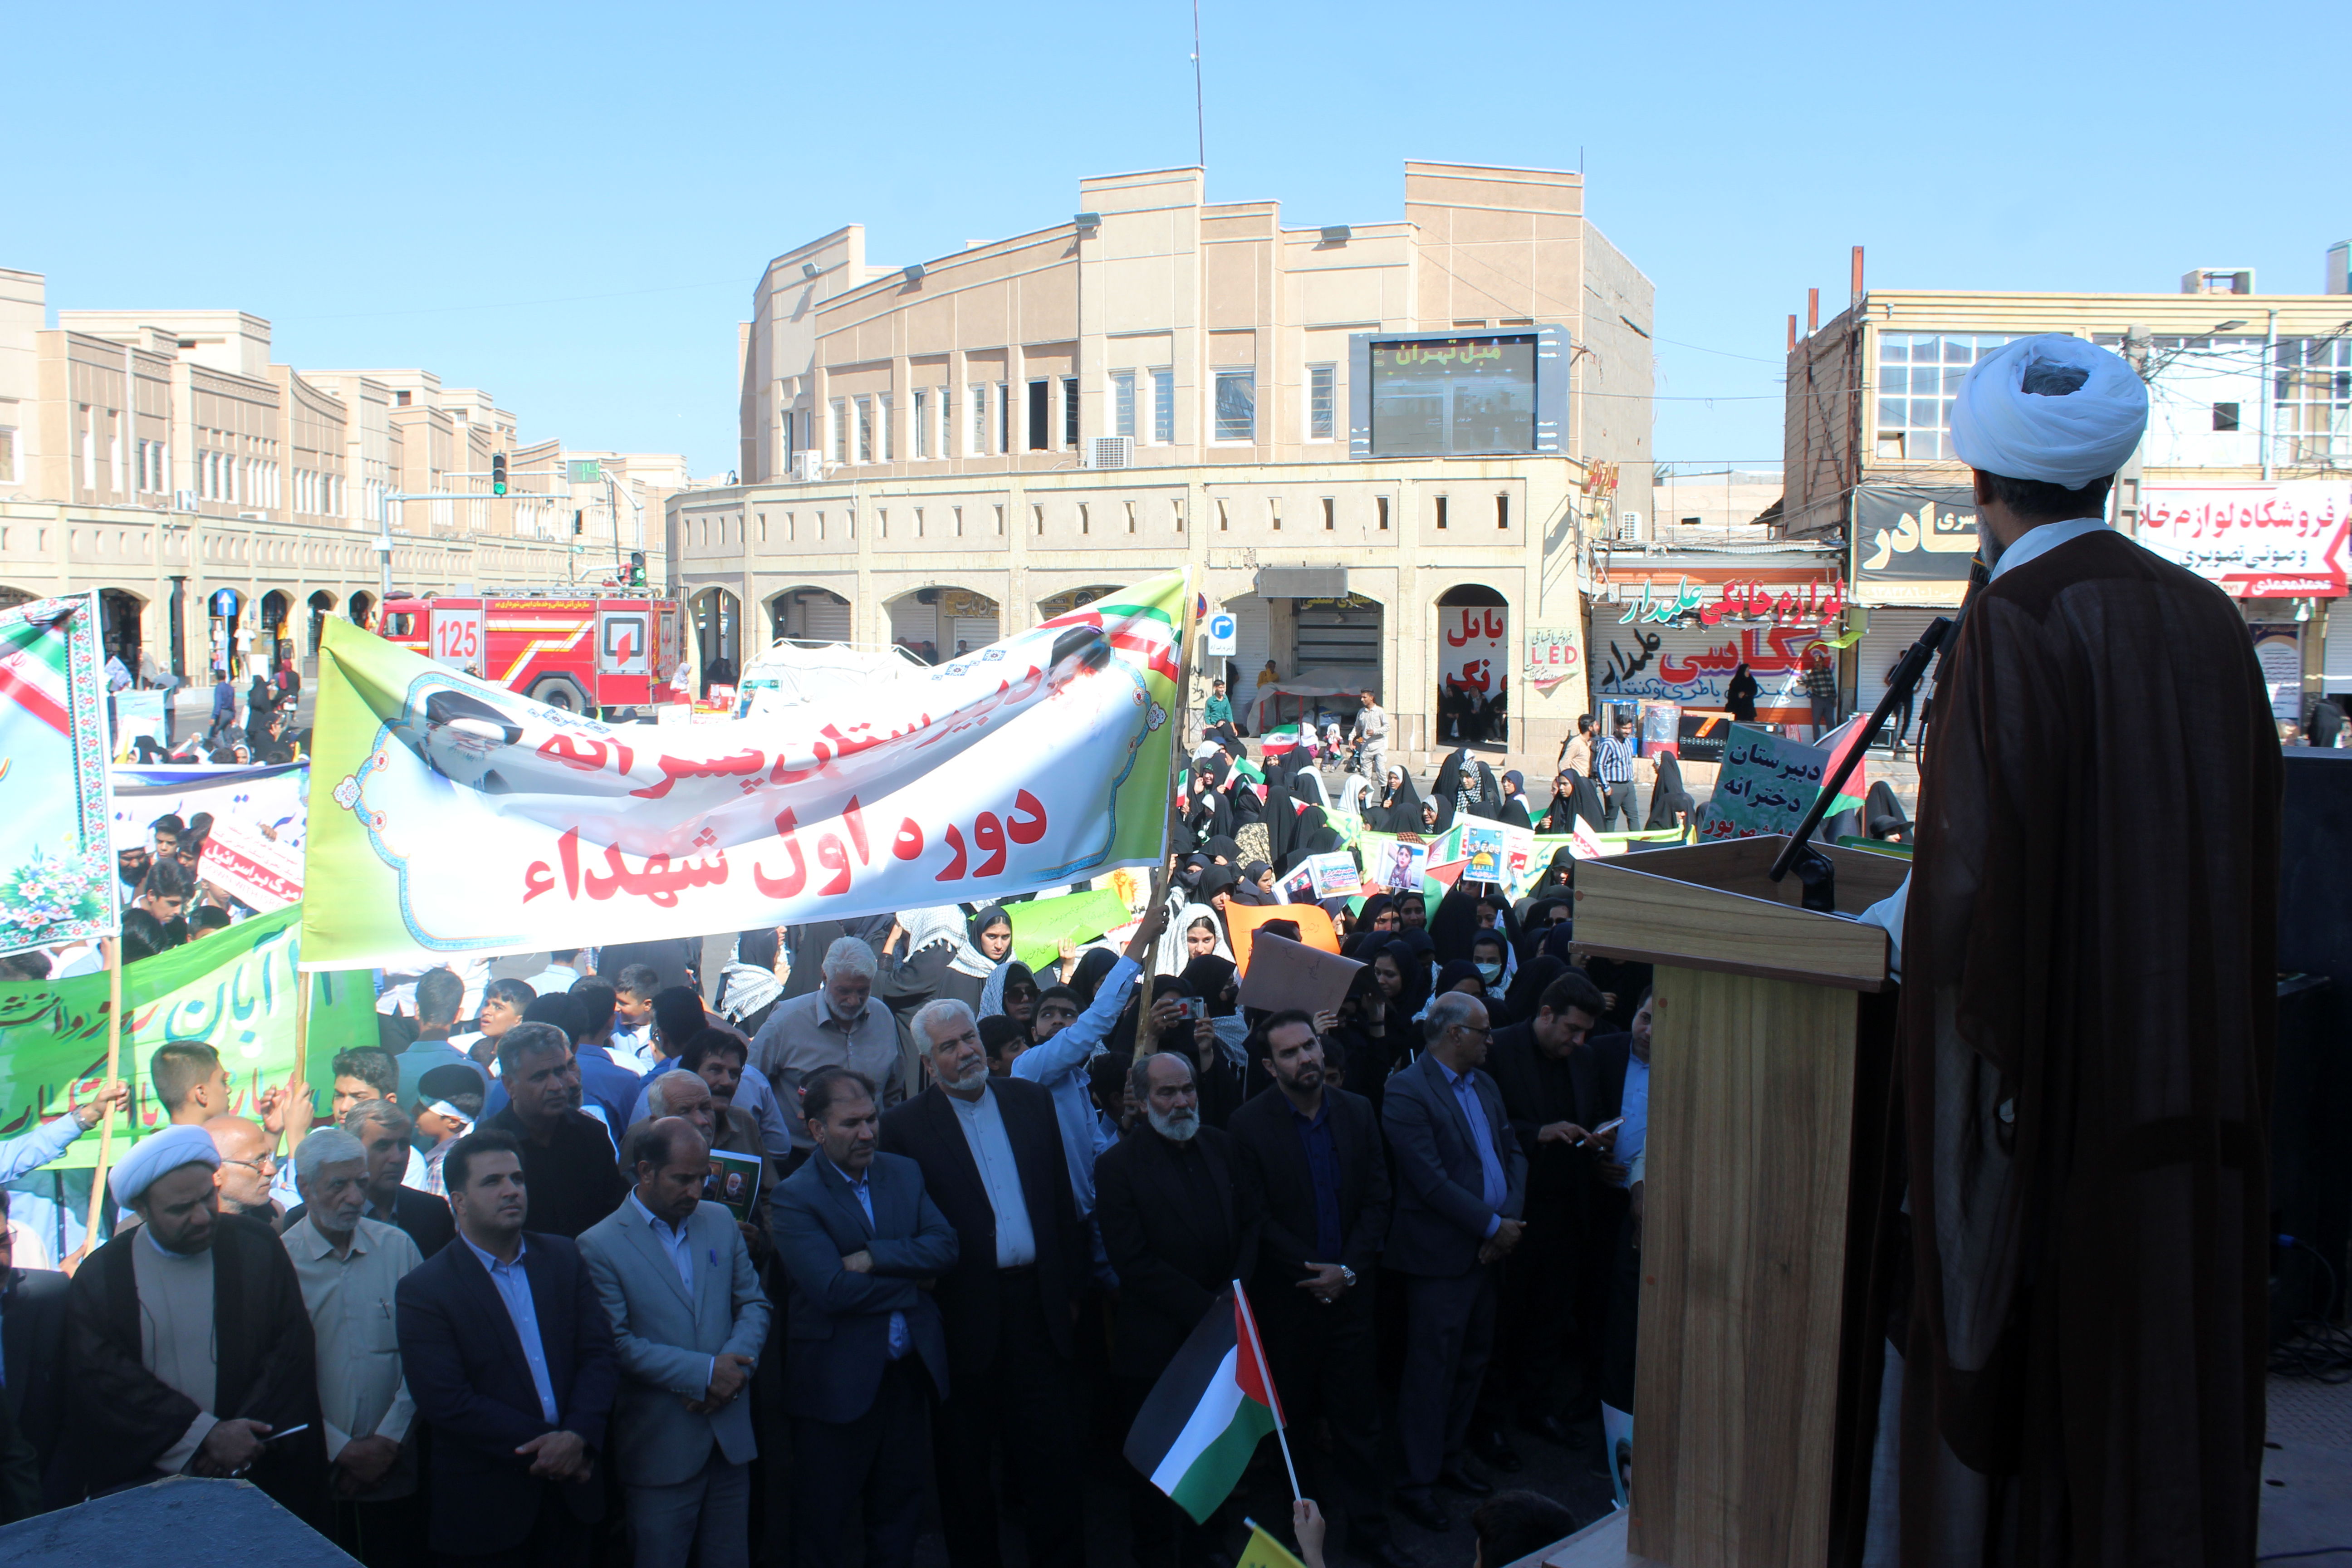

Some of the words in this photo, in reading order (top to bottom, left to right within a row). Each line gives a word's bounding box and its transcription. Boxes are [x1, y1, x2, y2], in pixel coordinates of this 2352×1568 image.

[1396, 339, 1456, 366] تهران
[1460, 342, 1501, 367] مبل
[1937, 512, 1978, 531] سری
[2138, 501, 2170, 528] خان
[2174, 501, 2235, 539] لوازم
[2240, 496, 2335, 538] فروشگاه
[1862, 501, 1980, 570] ادر
[2179, 544, 2244, 568] تصویری
[2244, 545, 2297, 568] صوتی
[2298, 549, 2308, 567] و
[500, 600, 519, 609] شهرداری
[551, 601, 564, 609] نشانی
[564, 600, 574, 609] آتش
[573, 601, 589, 609] سازمان
[1618, 574, 1704, 624] علمدار
[1700, 578, 1774, 625] خانگی
[1777, 577, 1845, 625] لوازم
[437, 620, 477, 657] 125
[1552, 630, 1573, 646] فروش
[1531, 646, 1578, 665] LED
[1602, 628, 1661, 686] علمدار
[1659, 627, 1834, 686] عکاسی
[1603, 676, 1660, 696] کنترل
[1662, 678, 1721, 704] باطری
[535, 732, 767, 800] پسرانه
[1729, 743, 1821, 783] دبیرستان
[1724, 776, 1801, 813] دخترانه
[753, 794, 871, 900] اول
[892, 788, 1048, 882] دوره
[204, 844, 256, 876] اسرائیل
[522, 824, 730, 909] شهداء
[247, 873, 269, 887] بر
[269, 878, 300, 900] مرگ
[260, 894, 282, 908] ISRA
[164, 924, 288, 1044] آبان
